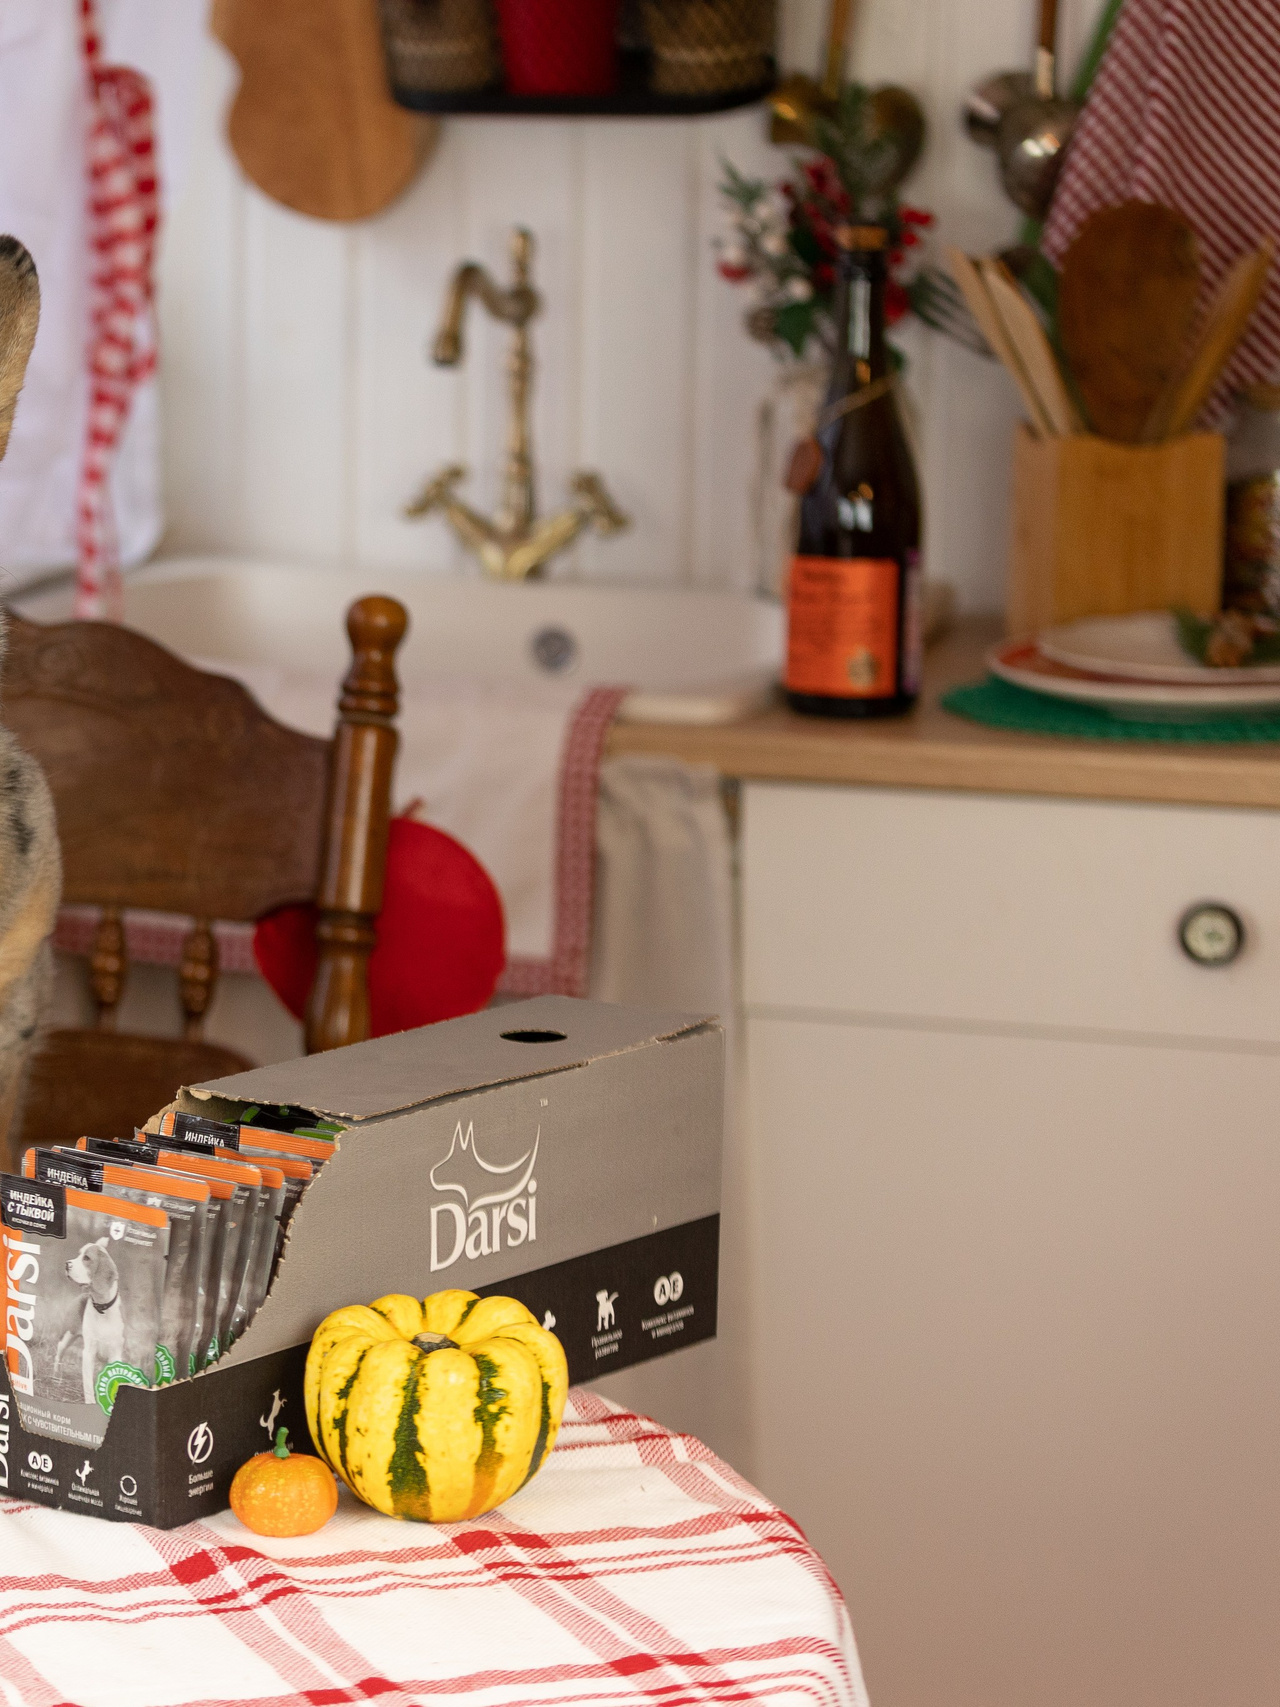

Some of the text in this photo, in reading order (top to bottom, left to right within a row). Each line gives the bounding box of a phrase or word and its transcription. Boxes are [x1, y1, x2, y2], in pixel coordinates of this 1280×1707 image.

[47, 1168, 88, 1187] ИНДЕЙКА
[10, 1190, 54, 1209] ИНДЕЙКА
[7, 1202, 54, 1222] С ТЫКВОЙ
[430, 1179, 537, 1272] Darsi
[3, 1234, 40, 1397] Darsi
[53, 1413, 71, 1425] корм
[33, 1418, 92, 1442] ЧУВСТВИТЕЛЬНЫМ
[188, 1470, 213, 1484] Больше
[188, 1482, 214, 1497] энергии
